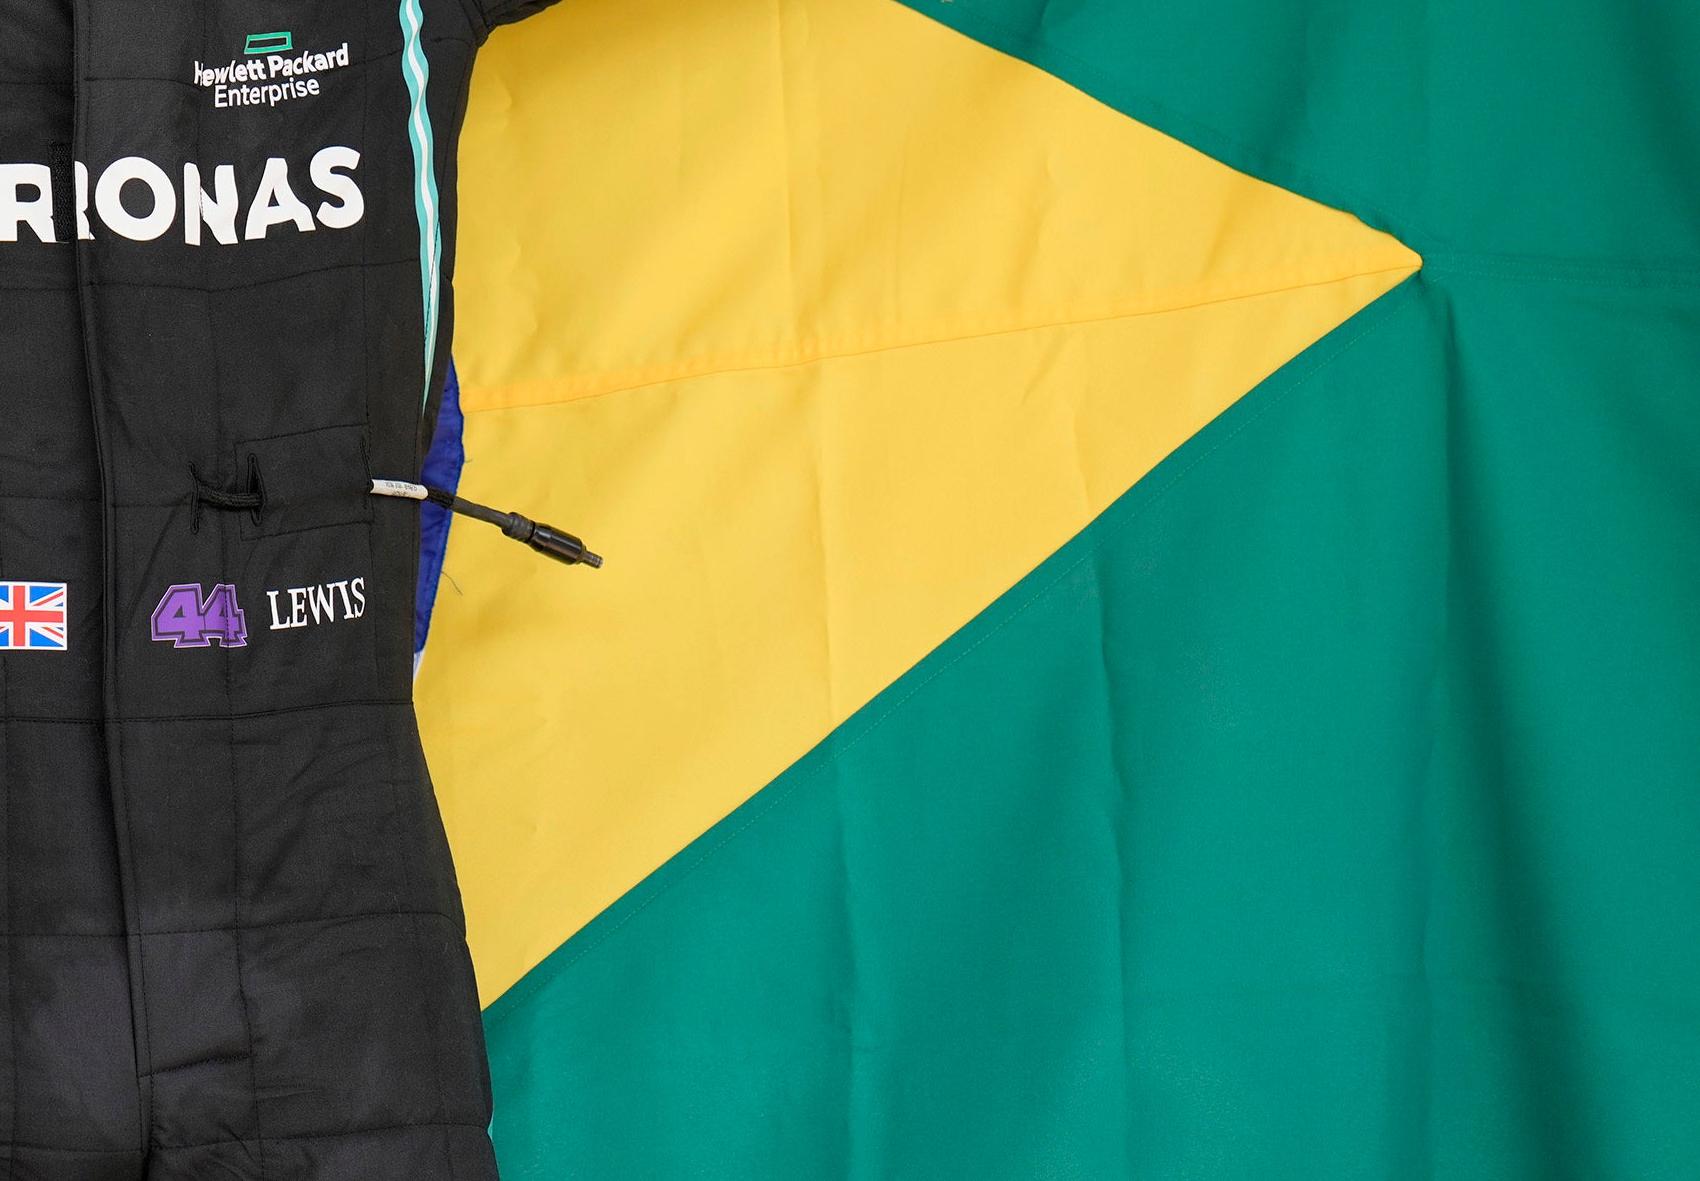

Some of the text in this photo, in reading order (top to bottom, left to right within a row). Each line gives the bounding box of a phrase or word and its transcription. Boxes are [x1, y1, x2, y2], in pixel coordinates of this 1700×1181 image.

[266, 42, 350, 79] Packard
[214, 77, 321, 109] Enterprise
[151, 576, 367, 648] 44 LEWIS
